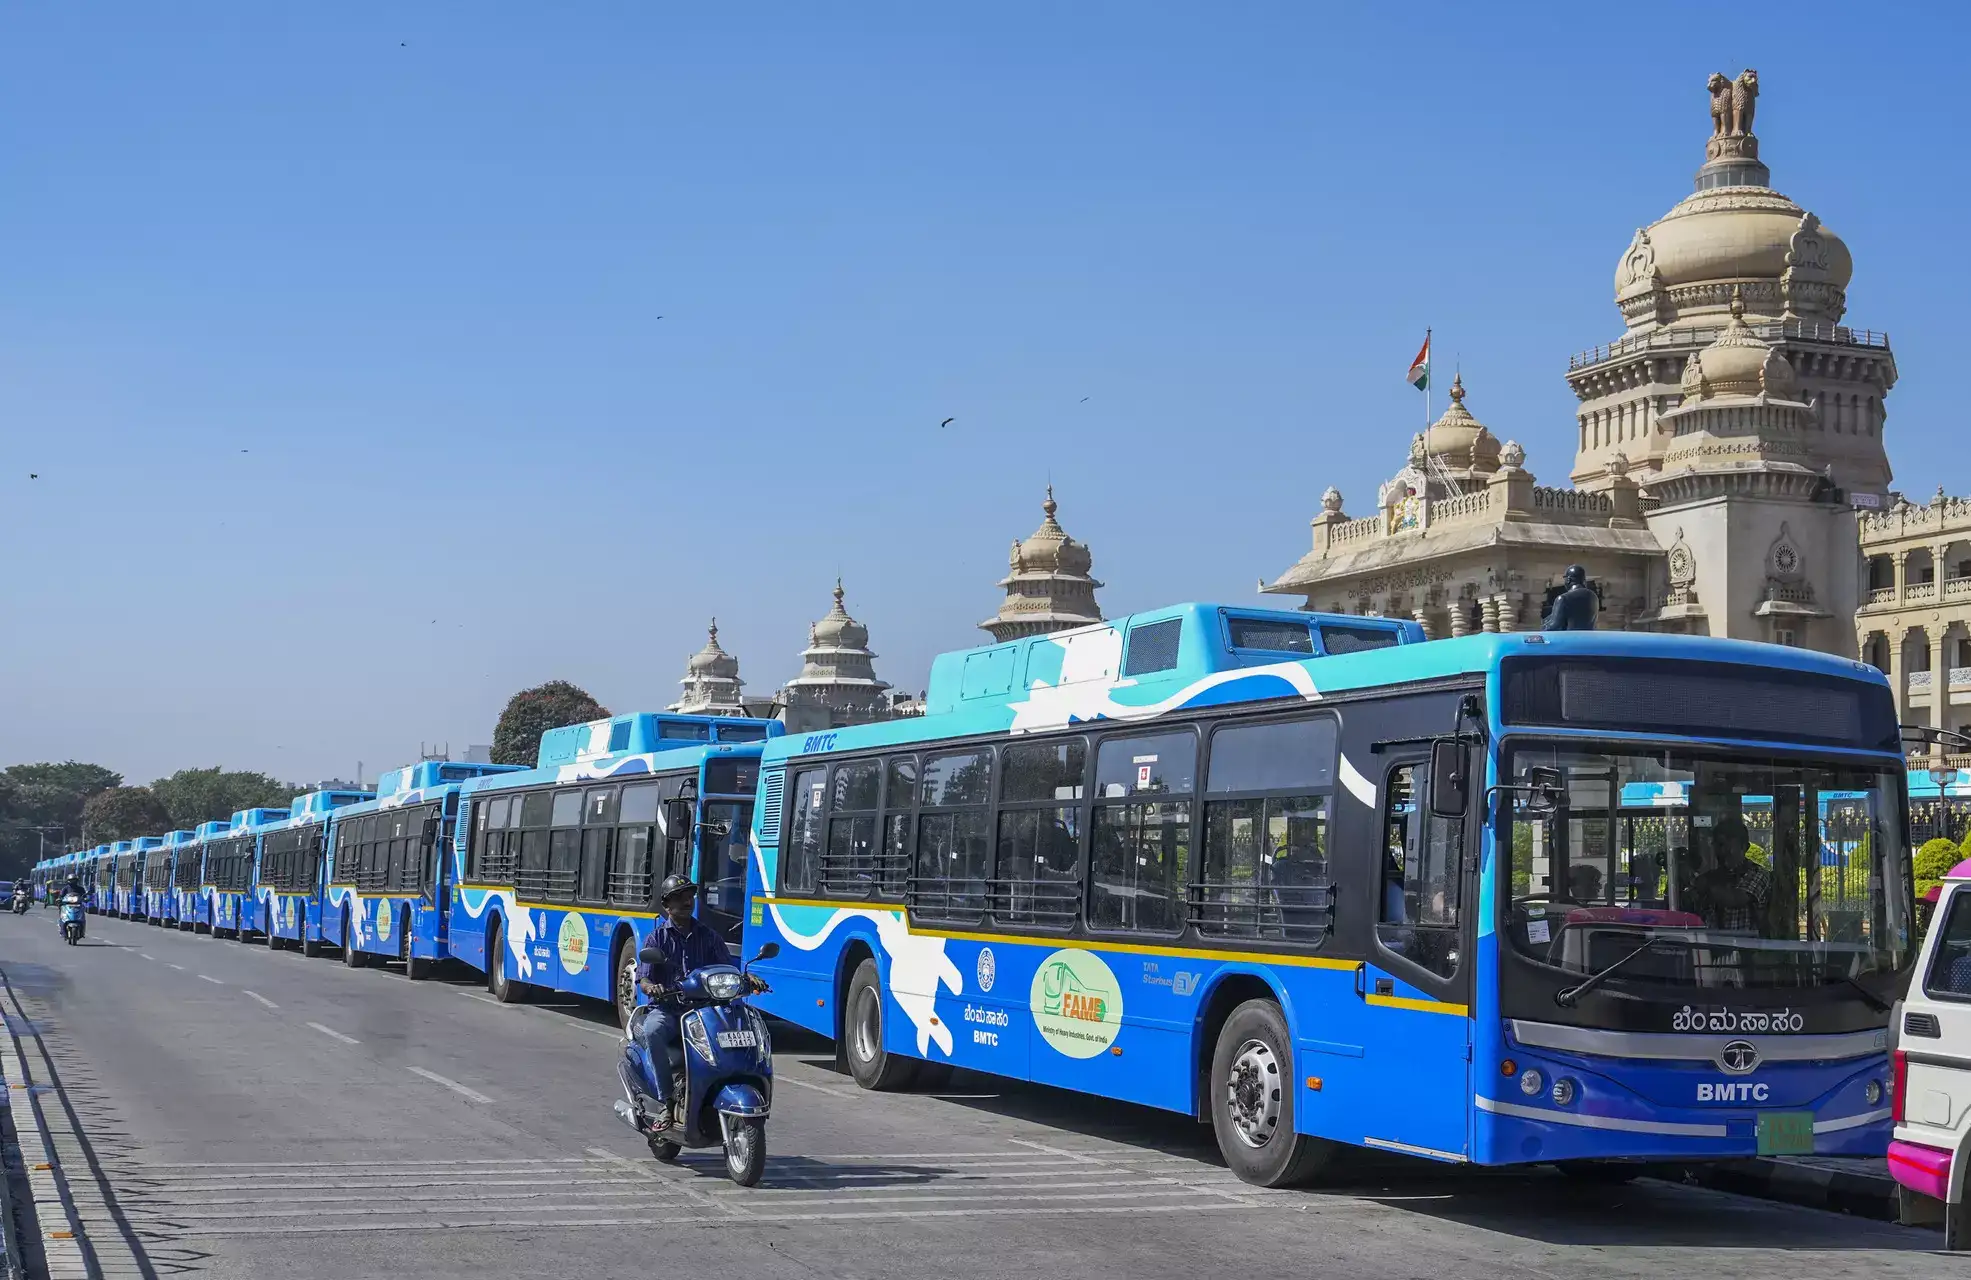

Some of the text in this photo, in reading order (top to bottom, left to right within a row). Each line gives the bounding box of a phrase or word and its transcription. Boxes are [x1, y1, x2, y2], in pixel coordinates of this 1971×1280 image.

[803, 733, 838, 753] BMTC
[1143, 961, 1159, 973] TATA
[1173, 971, 1203, 996] EV
[1063, 993, 1103, 1022] FAME
[973, 1029, 998, 1047] BMTC
[1696, 1083, 1769, 1101] BMTC
